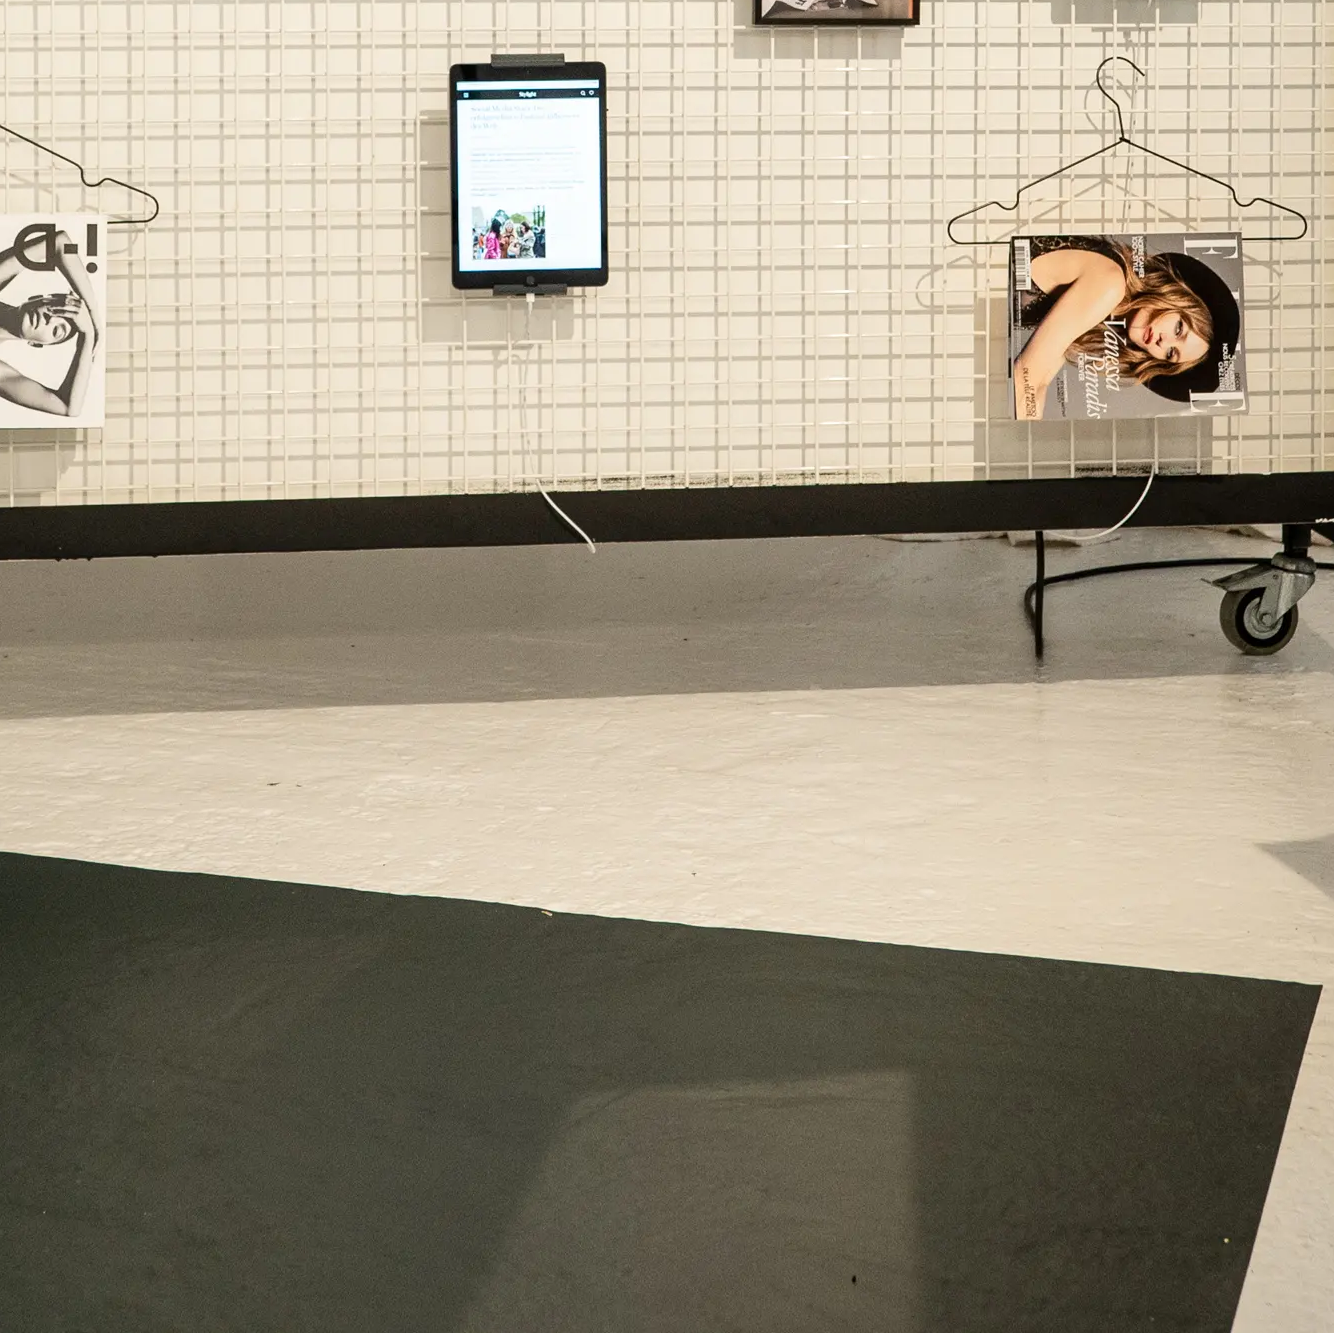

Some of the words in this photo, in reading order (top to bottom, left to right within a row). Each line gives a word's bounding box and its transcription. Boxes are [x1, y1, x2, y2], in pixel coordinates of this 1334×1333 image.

[1103, 318, 1127, 391] Vanessa
[1183, 236, 1247, 413] EE
[1084, 353, 1108, 419] Paradis
